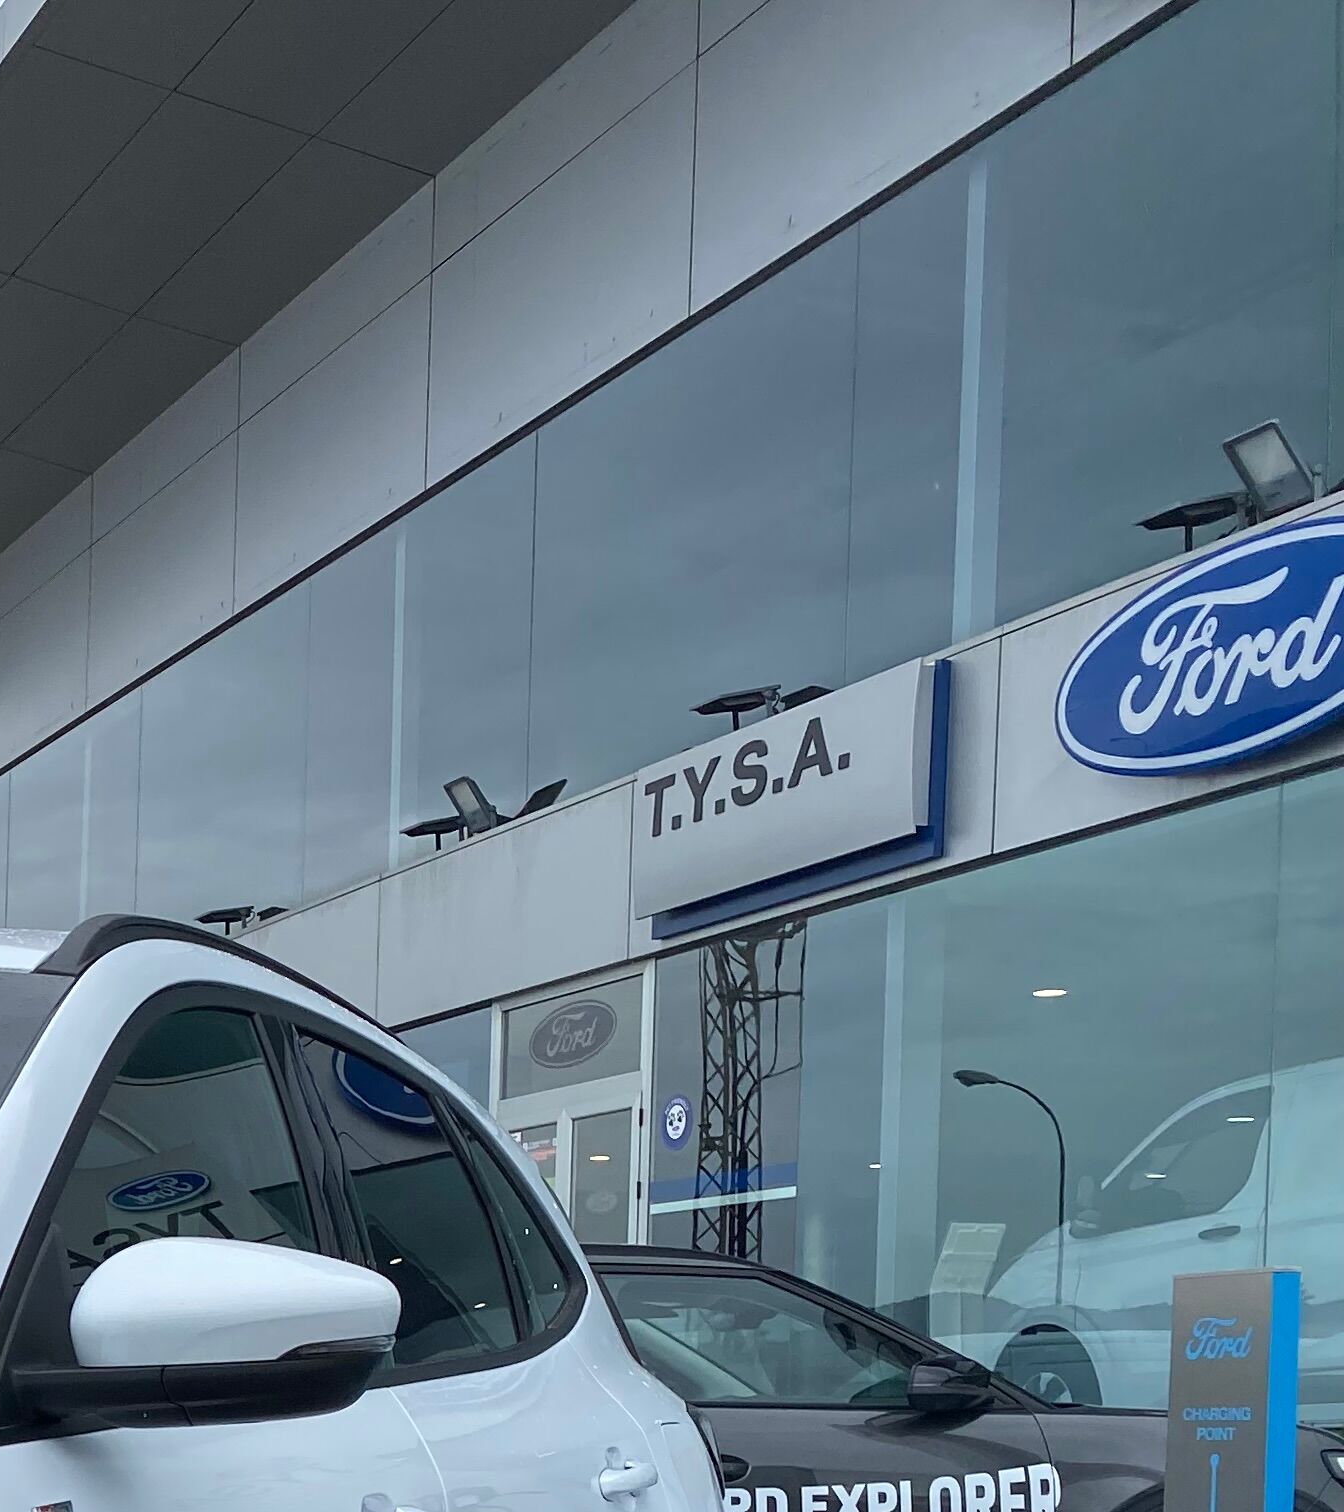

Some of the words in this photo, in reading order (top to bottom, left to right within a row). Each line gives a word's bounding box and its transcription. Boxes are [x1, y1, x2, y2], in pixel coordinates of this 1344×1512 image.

[1118, 567, 1344, 735] Ford
[644, 716, 852, 837] T.Y.S.A.
[546, 1011, 599, 1057] Ford
[1185, 1317, 1253, 1361] Ford
[1183, 1406, 1252, 1421] CHARGING
[1196, 1427, 1237, 1441] POINT
